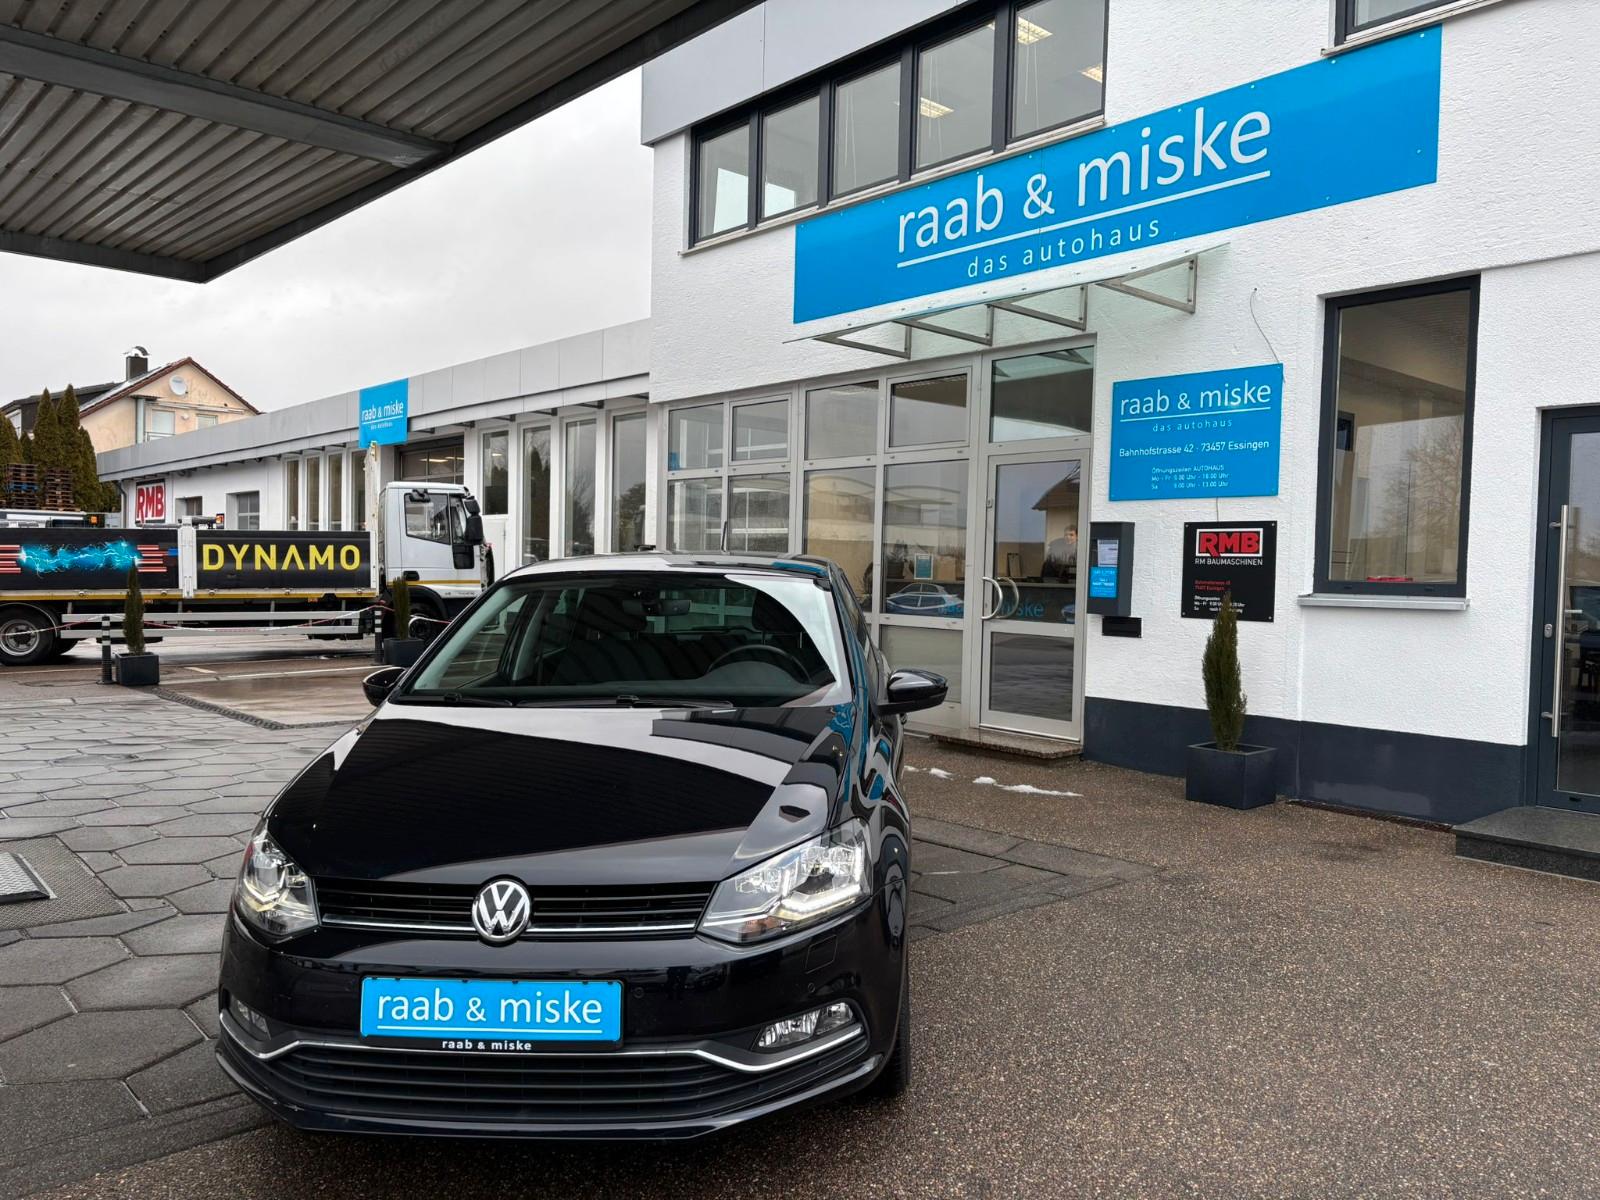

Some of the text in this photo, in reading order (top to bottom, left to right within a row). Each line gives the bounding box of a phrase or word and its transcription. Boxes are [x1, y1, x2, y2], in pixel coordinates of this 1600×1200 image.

[898, 107, 1271, 253] raab & miske
[967, 219, 1160, 278] das autohaus
[362, 404, 376, 421] raab
[384, 400, 404, 416] miske
[1120, 380, 1271, 416] raab & miske
[1152, 419, 1233, 432] das autohaus
[1119, 446, 1182, 457] Bahnhofstrasse
[1183, 443, 1194, 453] 42
[1201, 441, 1226, 453] 73457
[1228, 440, 1270, 451] Essingen
[1193, 464, 1225, 472] AUTOHAUS
[137, 487, 165, 523] RMB
[202, 543, 361, 571] DYNAMO
[1199, 532, 1259, 557] RMB
[1207, 558, 1263, 566] BAUMASCHINEN
[378, 988, 603, 1024] raab & miske
[442, 1039, 532, 1051] raab & miske
